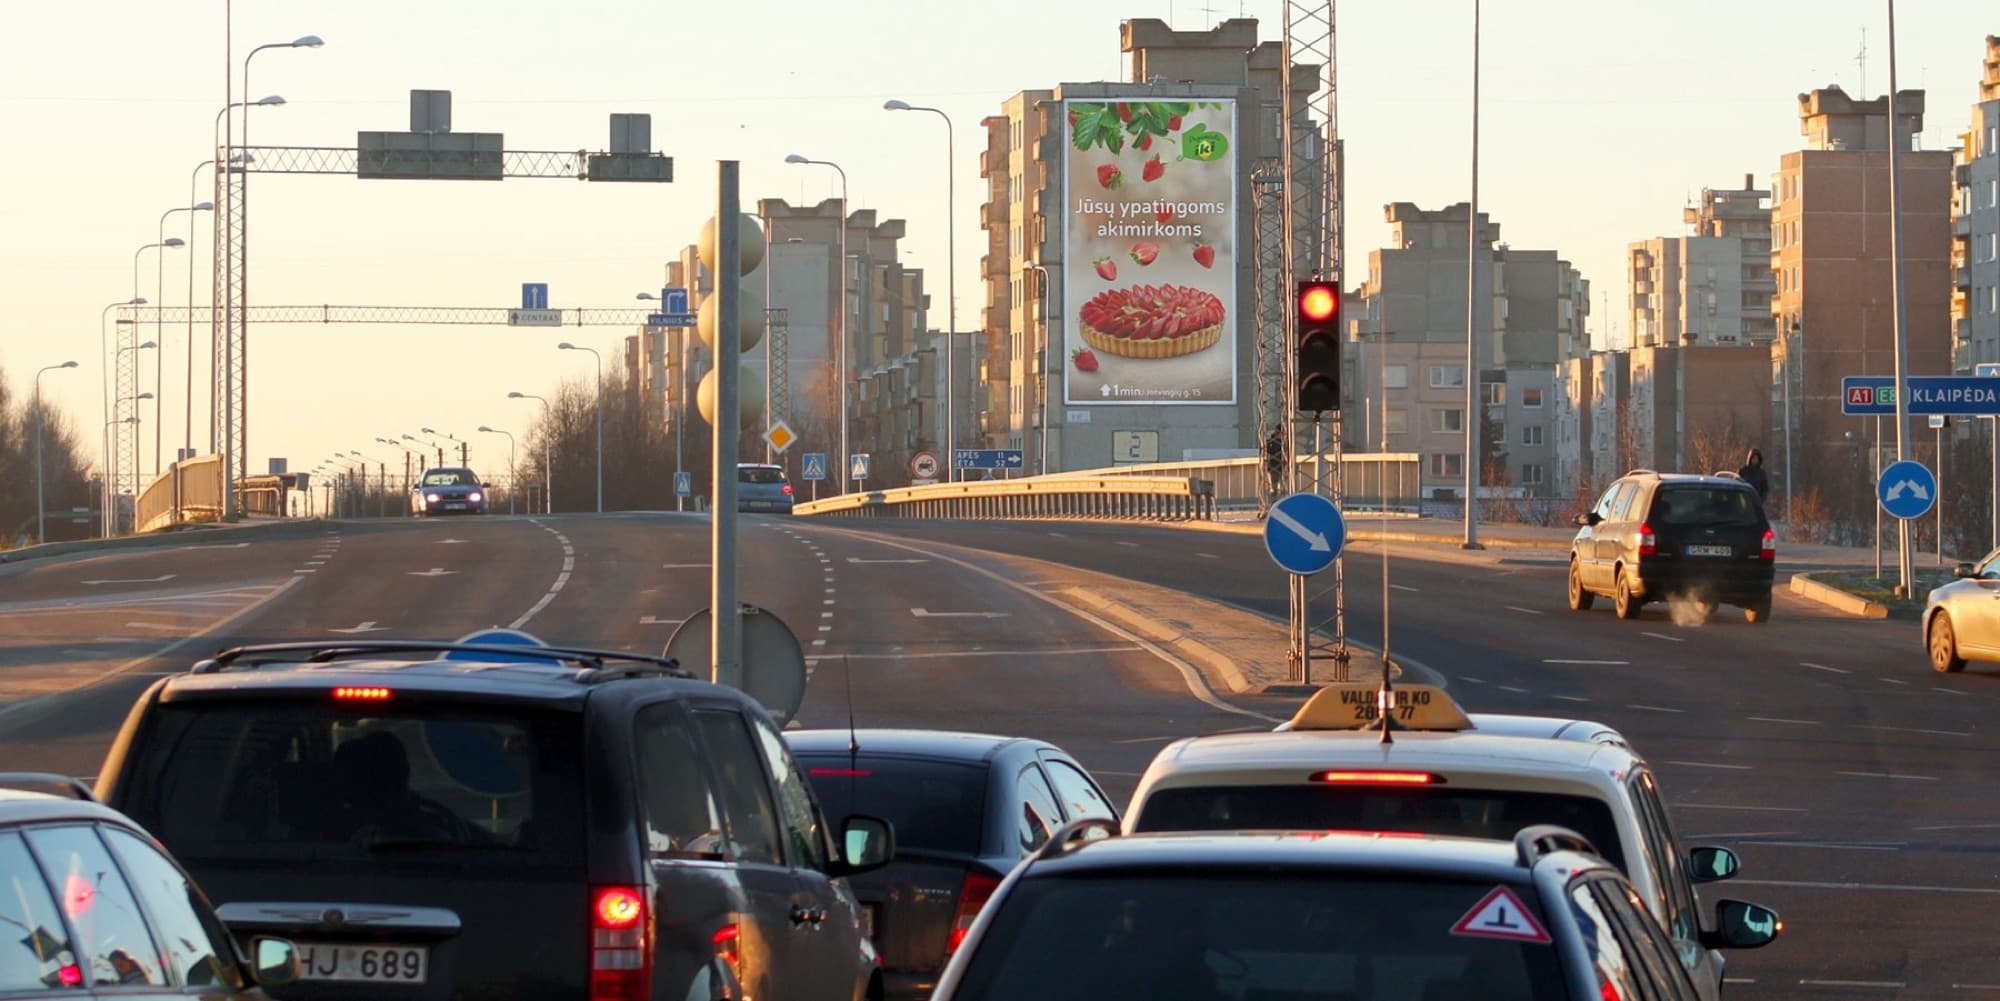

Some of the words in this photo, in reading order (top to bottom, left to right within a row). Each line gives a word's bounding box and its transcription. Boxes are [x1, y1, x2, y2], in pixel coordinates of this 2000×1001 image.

[1195, 141, 1215, 156] iki
[1075, 197, 1114, 218] Jūsų
[1119, 198, 1225, 217] ypatingoms
[1097, 221, 1202, 236] akimirkoms
[650, 317, 682, 325] VILNIUS
[1851, 389, 1869, 402] A1
[1880, 389, 1896, 402] E8
[1913, 387, 1996, 402] KLAIPĖDA
[957, 450, 979, 459] APĖS
[1412, 691, 1430, 705] KO
[301, 947, 339, 976] HJ
[361, 949, 420, 979] 689
